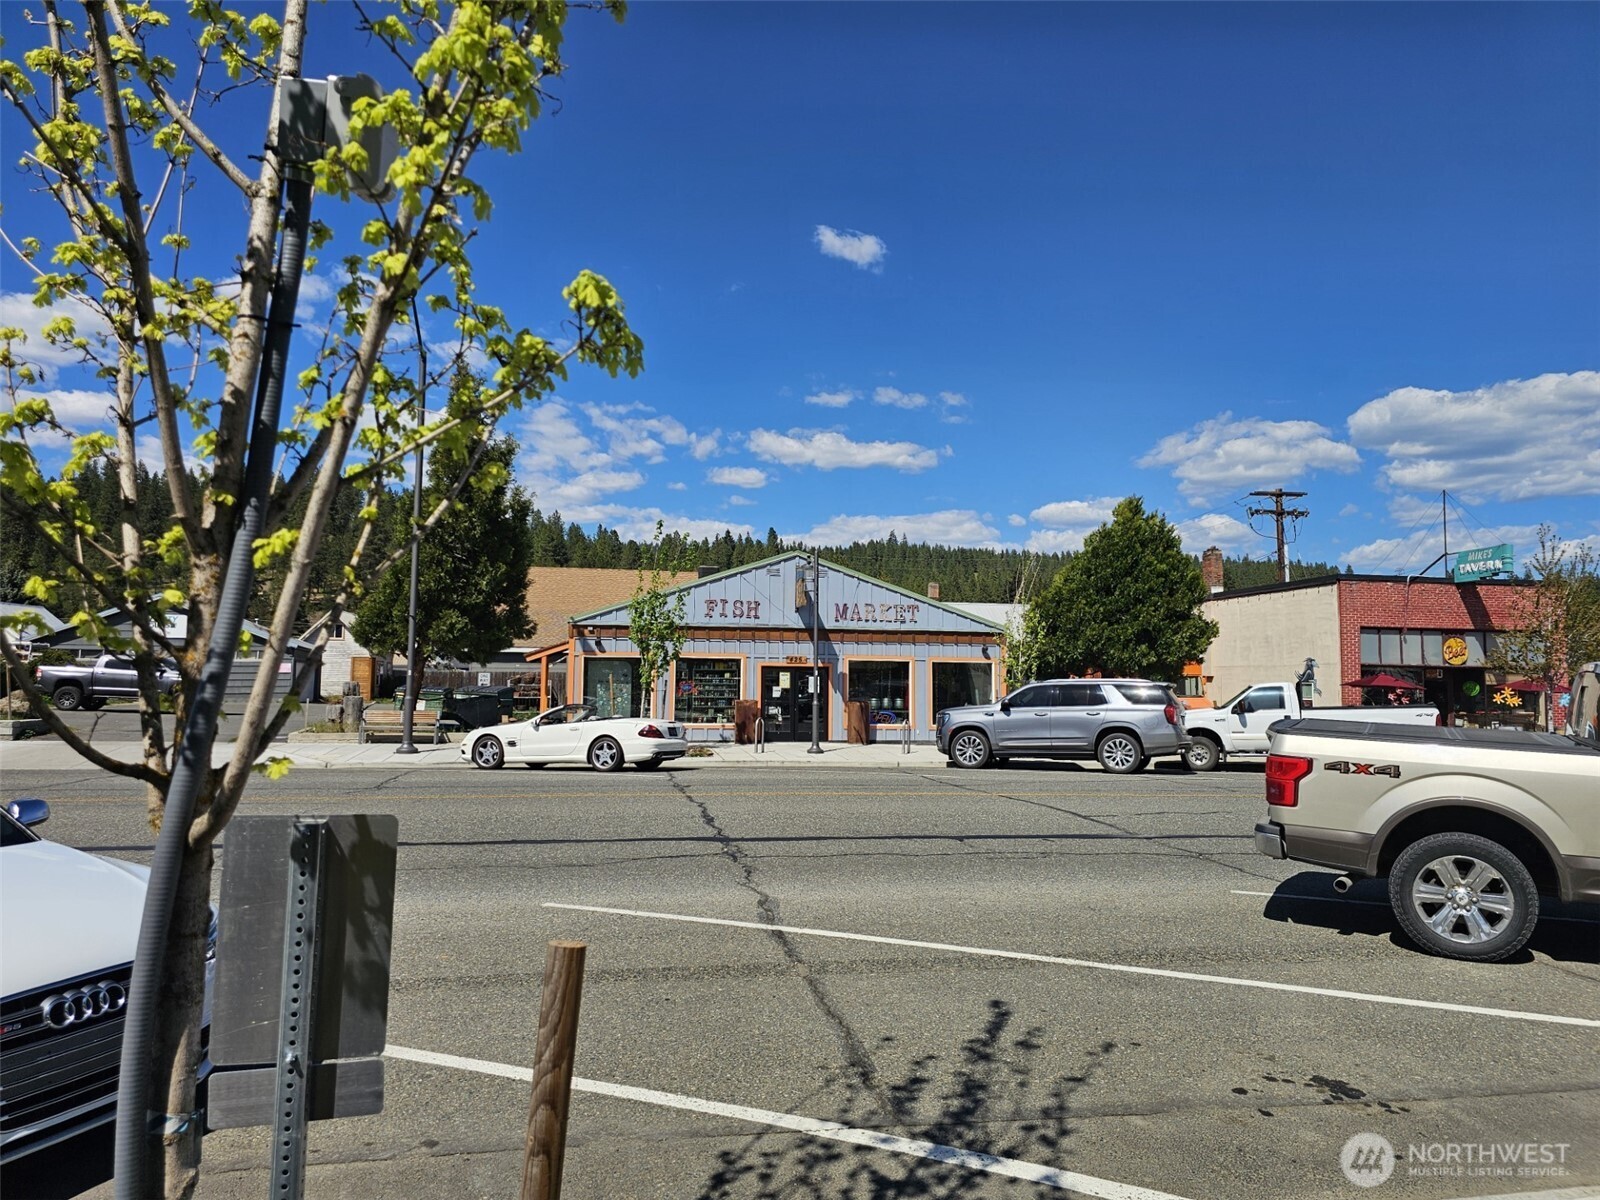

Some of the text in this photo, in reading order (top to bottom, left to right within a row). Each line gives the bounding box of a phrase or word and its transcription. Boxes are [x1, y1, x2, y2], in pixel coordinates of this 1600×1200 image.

[1468, 549, 1492, 561] MIKES
[1459, 559, 1503, 574] TAVERN
[704, 598, 920, 623] FISH MARKET
[1444, 645, 1467, 660] Beer
